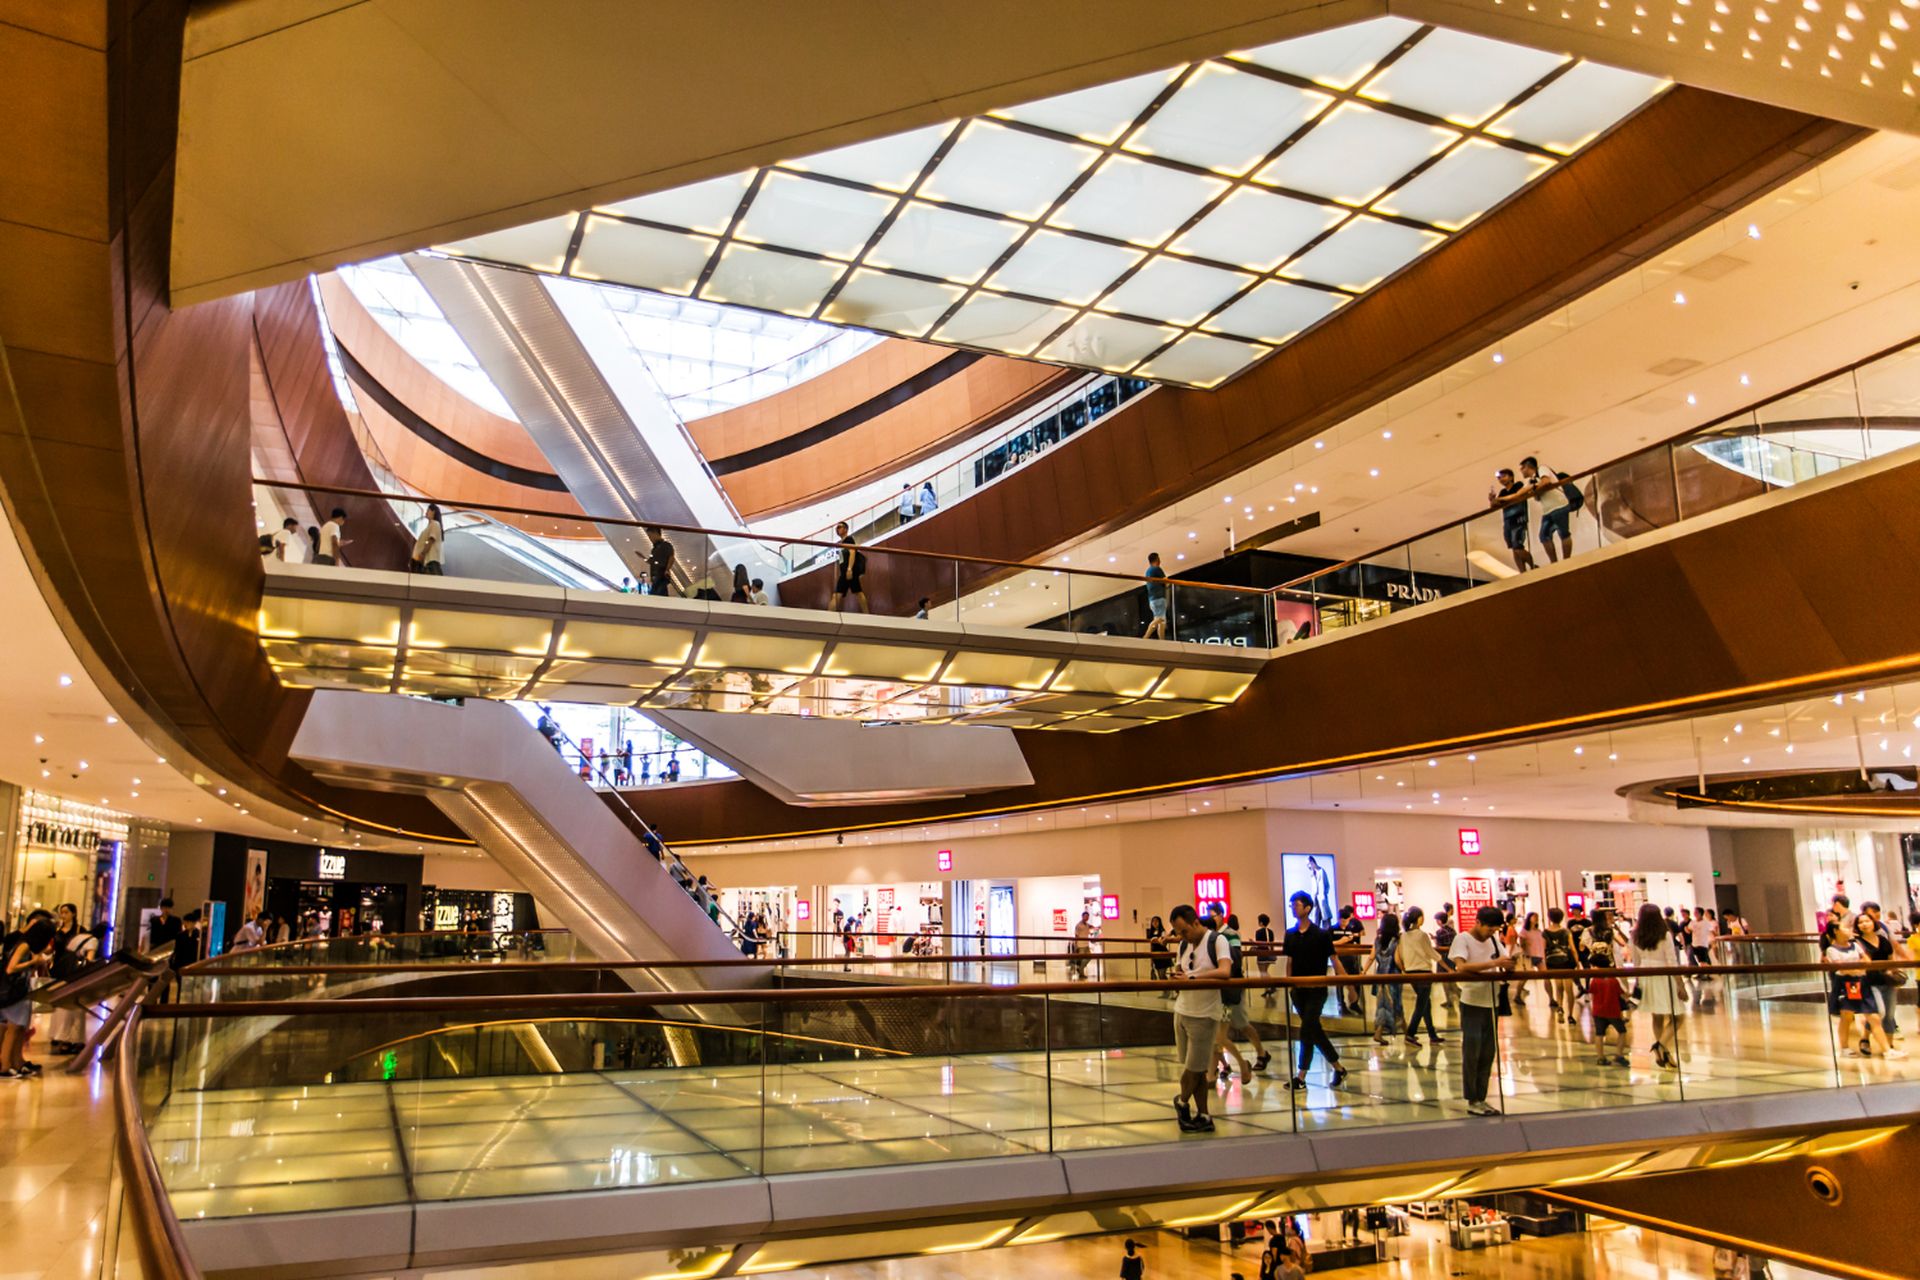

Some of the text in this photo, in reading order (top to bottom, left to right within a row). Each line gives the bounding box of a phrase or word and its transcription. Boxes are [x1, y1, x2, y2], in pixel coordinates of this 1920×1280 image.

[1387, 582, 1442, 602] PRADA
[320, 848, 346, 875] izzue
[1197, 878, 1225, 899] UNI
[1461, 881, 1488, 895] SALE
[1355, 894, 1372, 906] UNI
[434, 898, 459, 925] izzue
[1356, 905, 1375, 919] QLO
